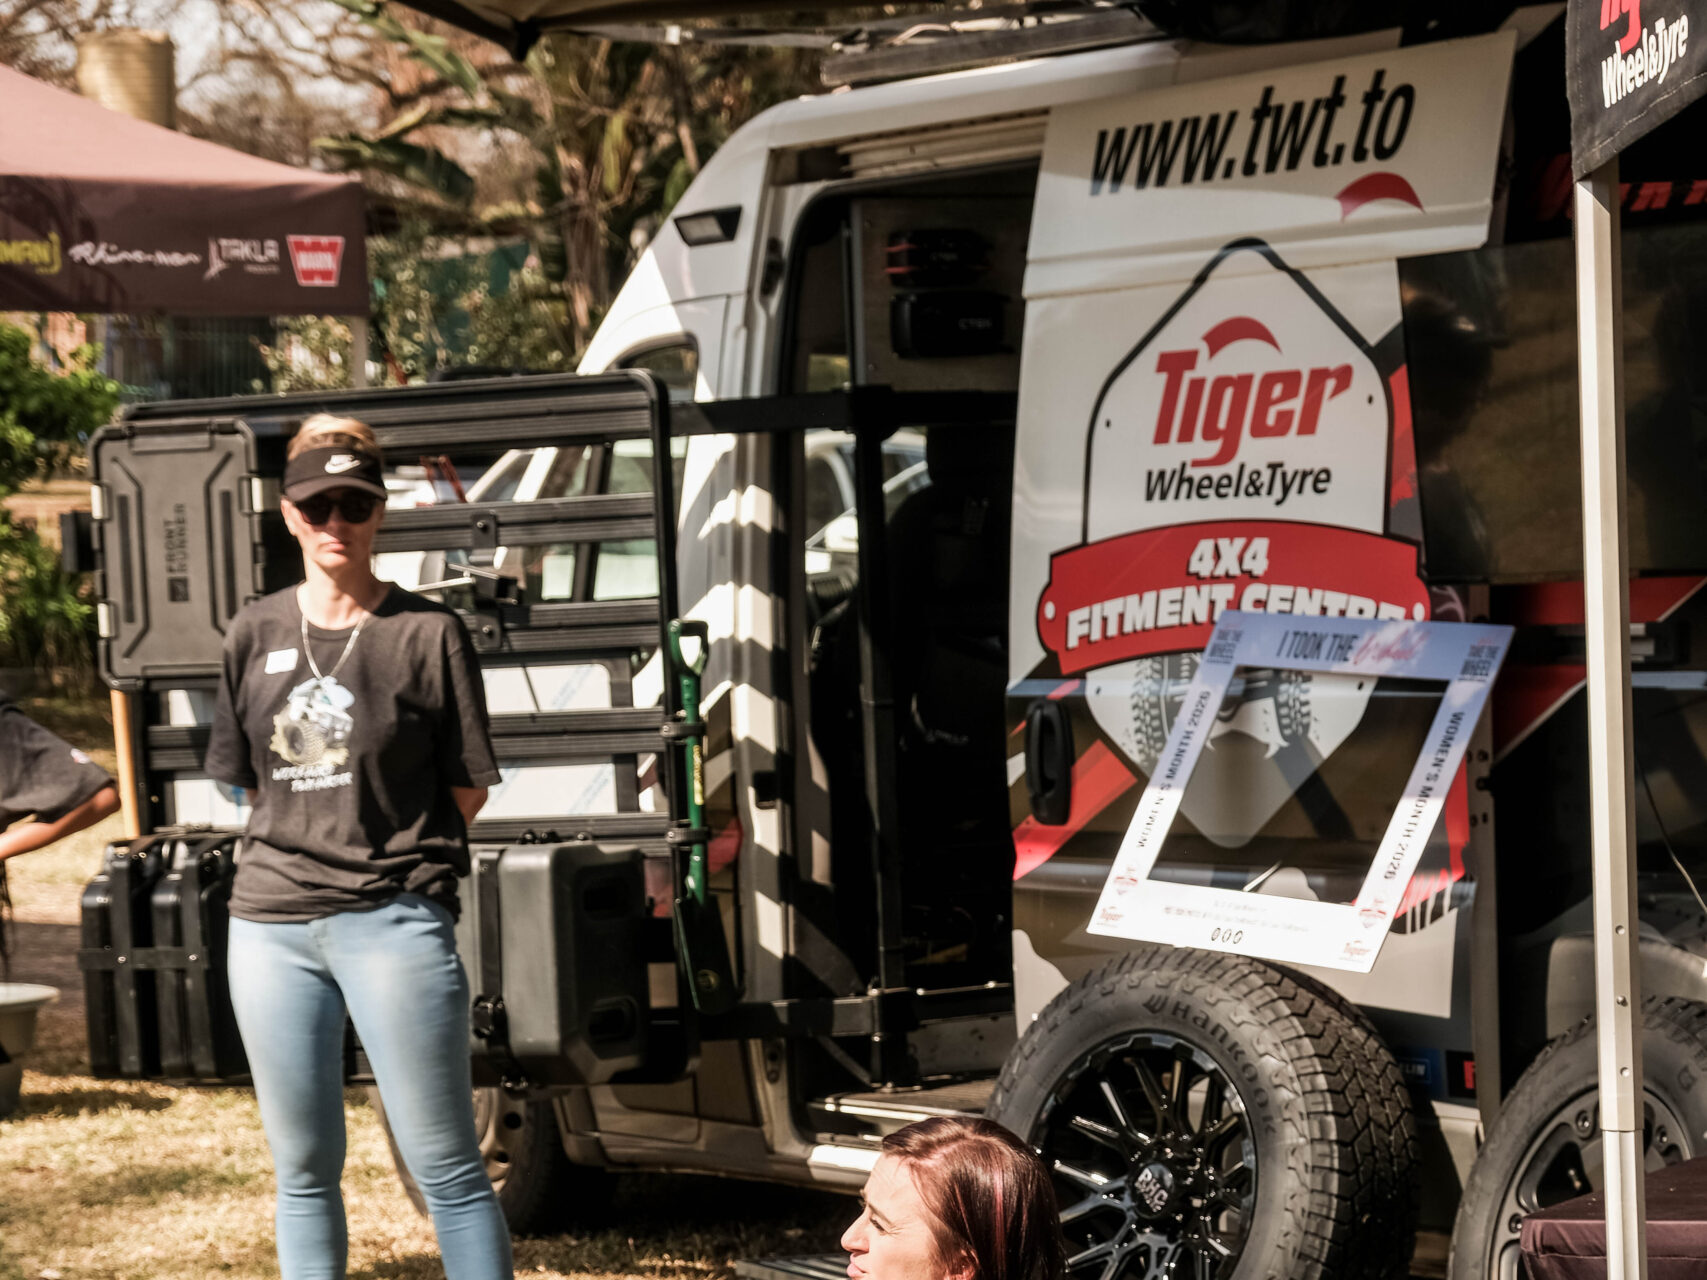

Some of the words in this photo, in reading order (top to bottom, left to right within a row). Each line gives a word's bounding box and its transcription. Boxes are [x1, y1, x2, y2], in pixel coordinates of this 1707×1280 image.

[1601, 14, 1688, 109] Wheel&Tyre
[1090, 69, 1416, 196] www.twt.to
[1153, 349, 1353, 468] Tiger
[1145, 461, 1332, 506] Wheel&Tyre
[164, 519, 175, 573] FRONT
[1187, 537, 1270, 578] 4X4
[1066, 583, 1236, 650] FITMENT
[1286, 631, 1328, 660] TOOK
[1325, 633, 1359, 662] THE
[1165, 730, 1194, 780] MONTH
[1425, 711, 1465, 783] WOMEN'S
[1402, 785, 1434, 838] MONTH
[1171, 1000, 1277, 1136] Hankook
